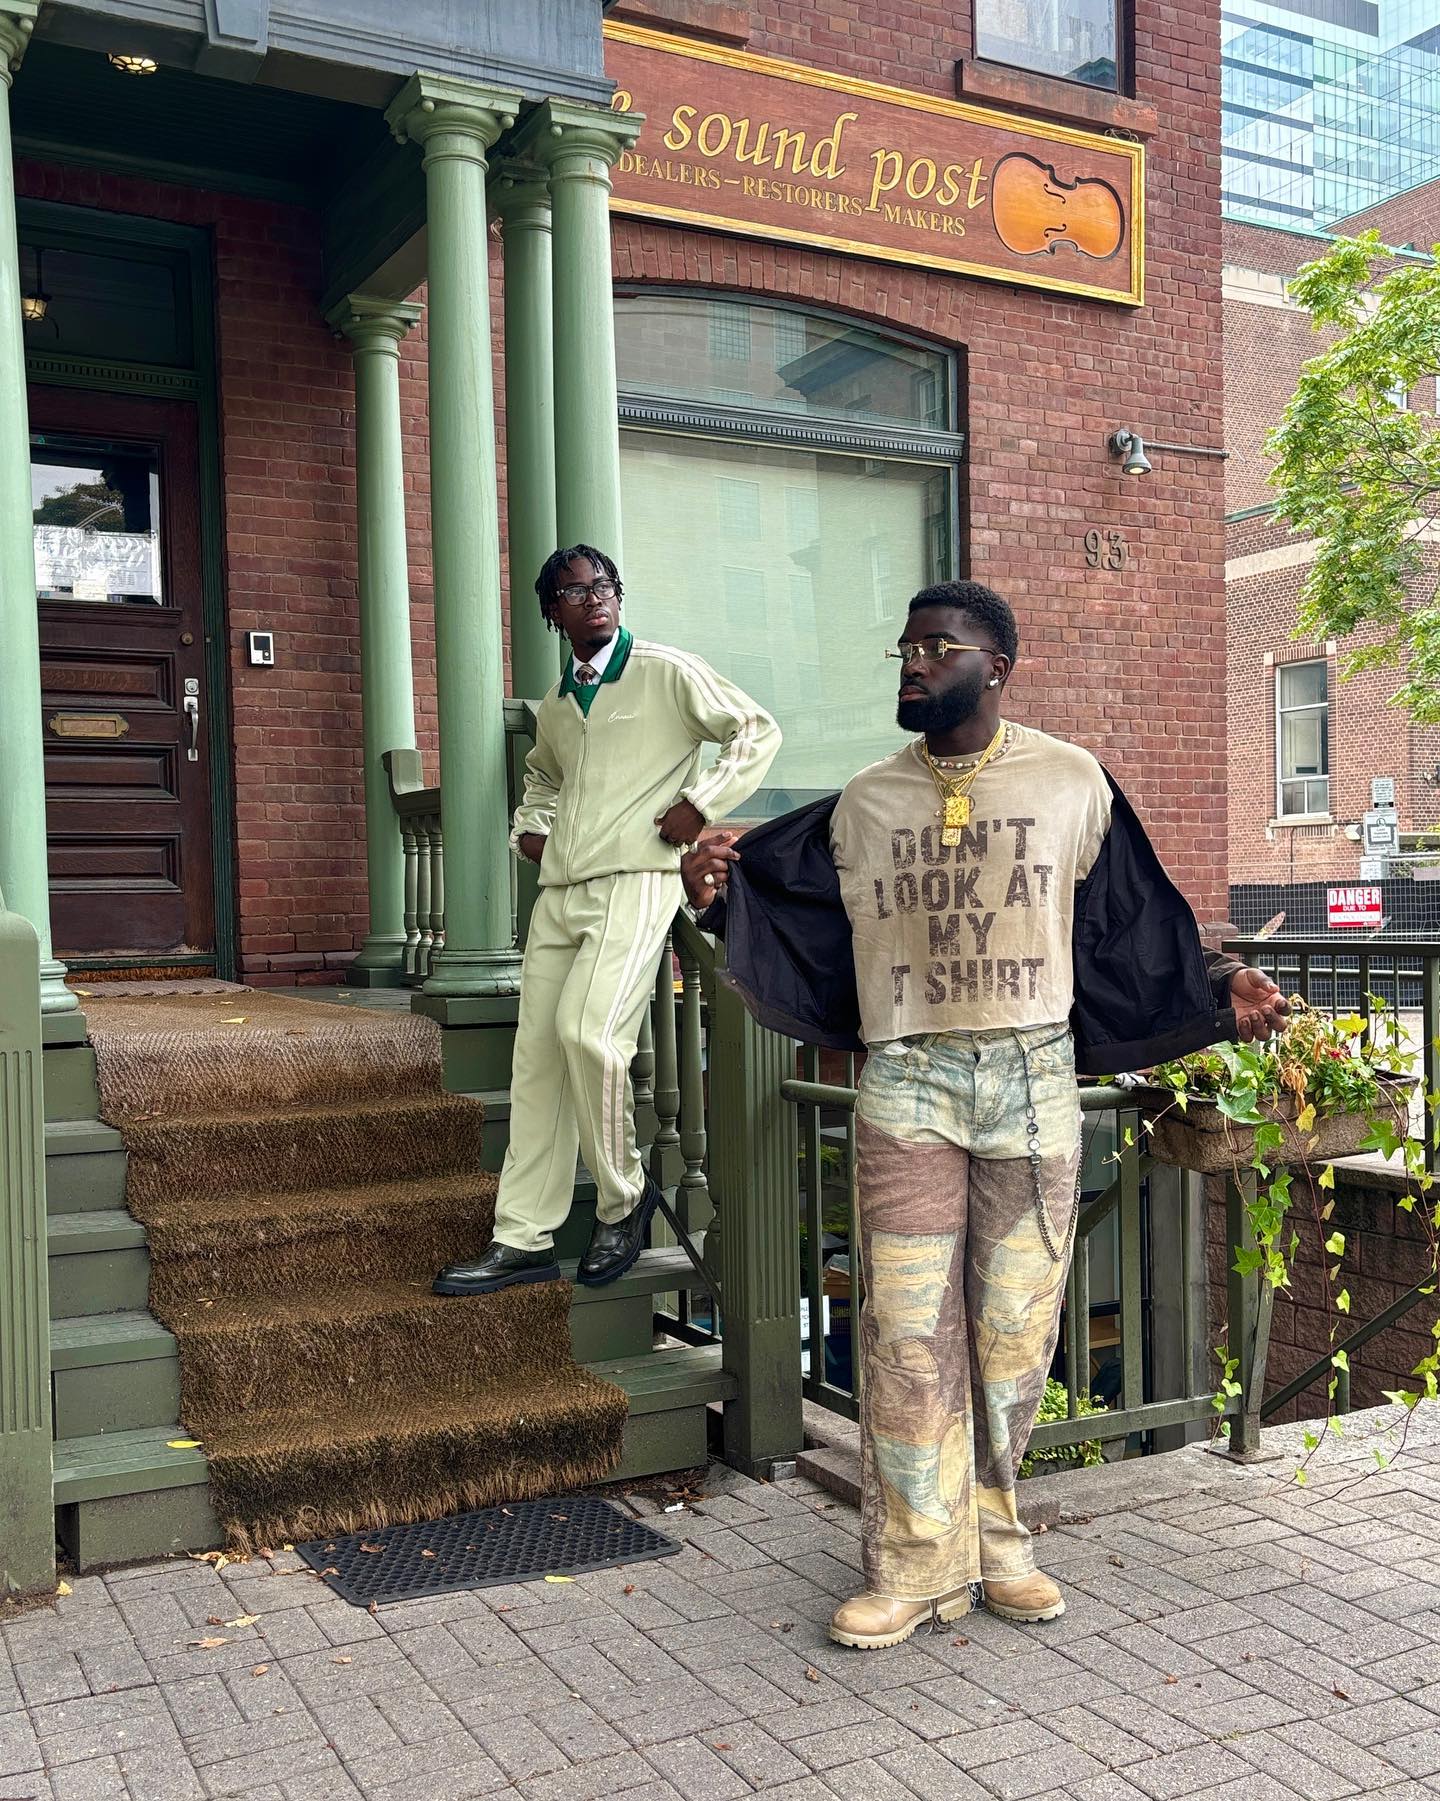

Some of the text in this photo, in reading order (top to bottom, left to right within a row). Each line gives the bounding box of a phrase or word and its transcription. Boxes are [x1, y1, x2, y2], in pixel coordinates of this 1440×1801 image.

[663, 104, 989, 211] sound post
[884, 203, 966, 237] MAKERS
[1085, 529, 1126, 569] 93
[891, 818, 1035, 869] DON'T
[874, 864, 1053, 920] LOOK AT
[1329, 888, 1380, 906] DANGER
[1342, 904, 1355, 912] DUE
[928, 912, 996, 957] MY
[891, 958, 1044, 1007] T SHIRT
